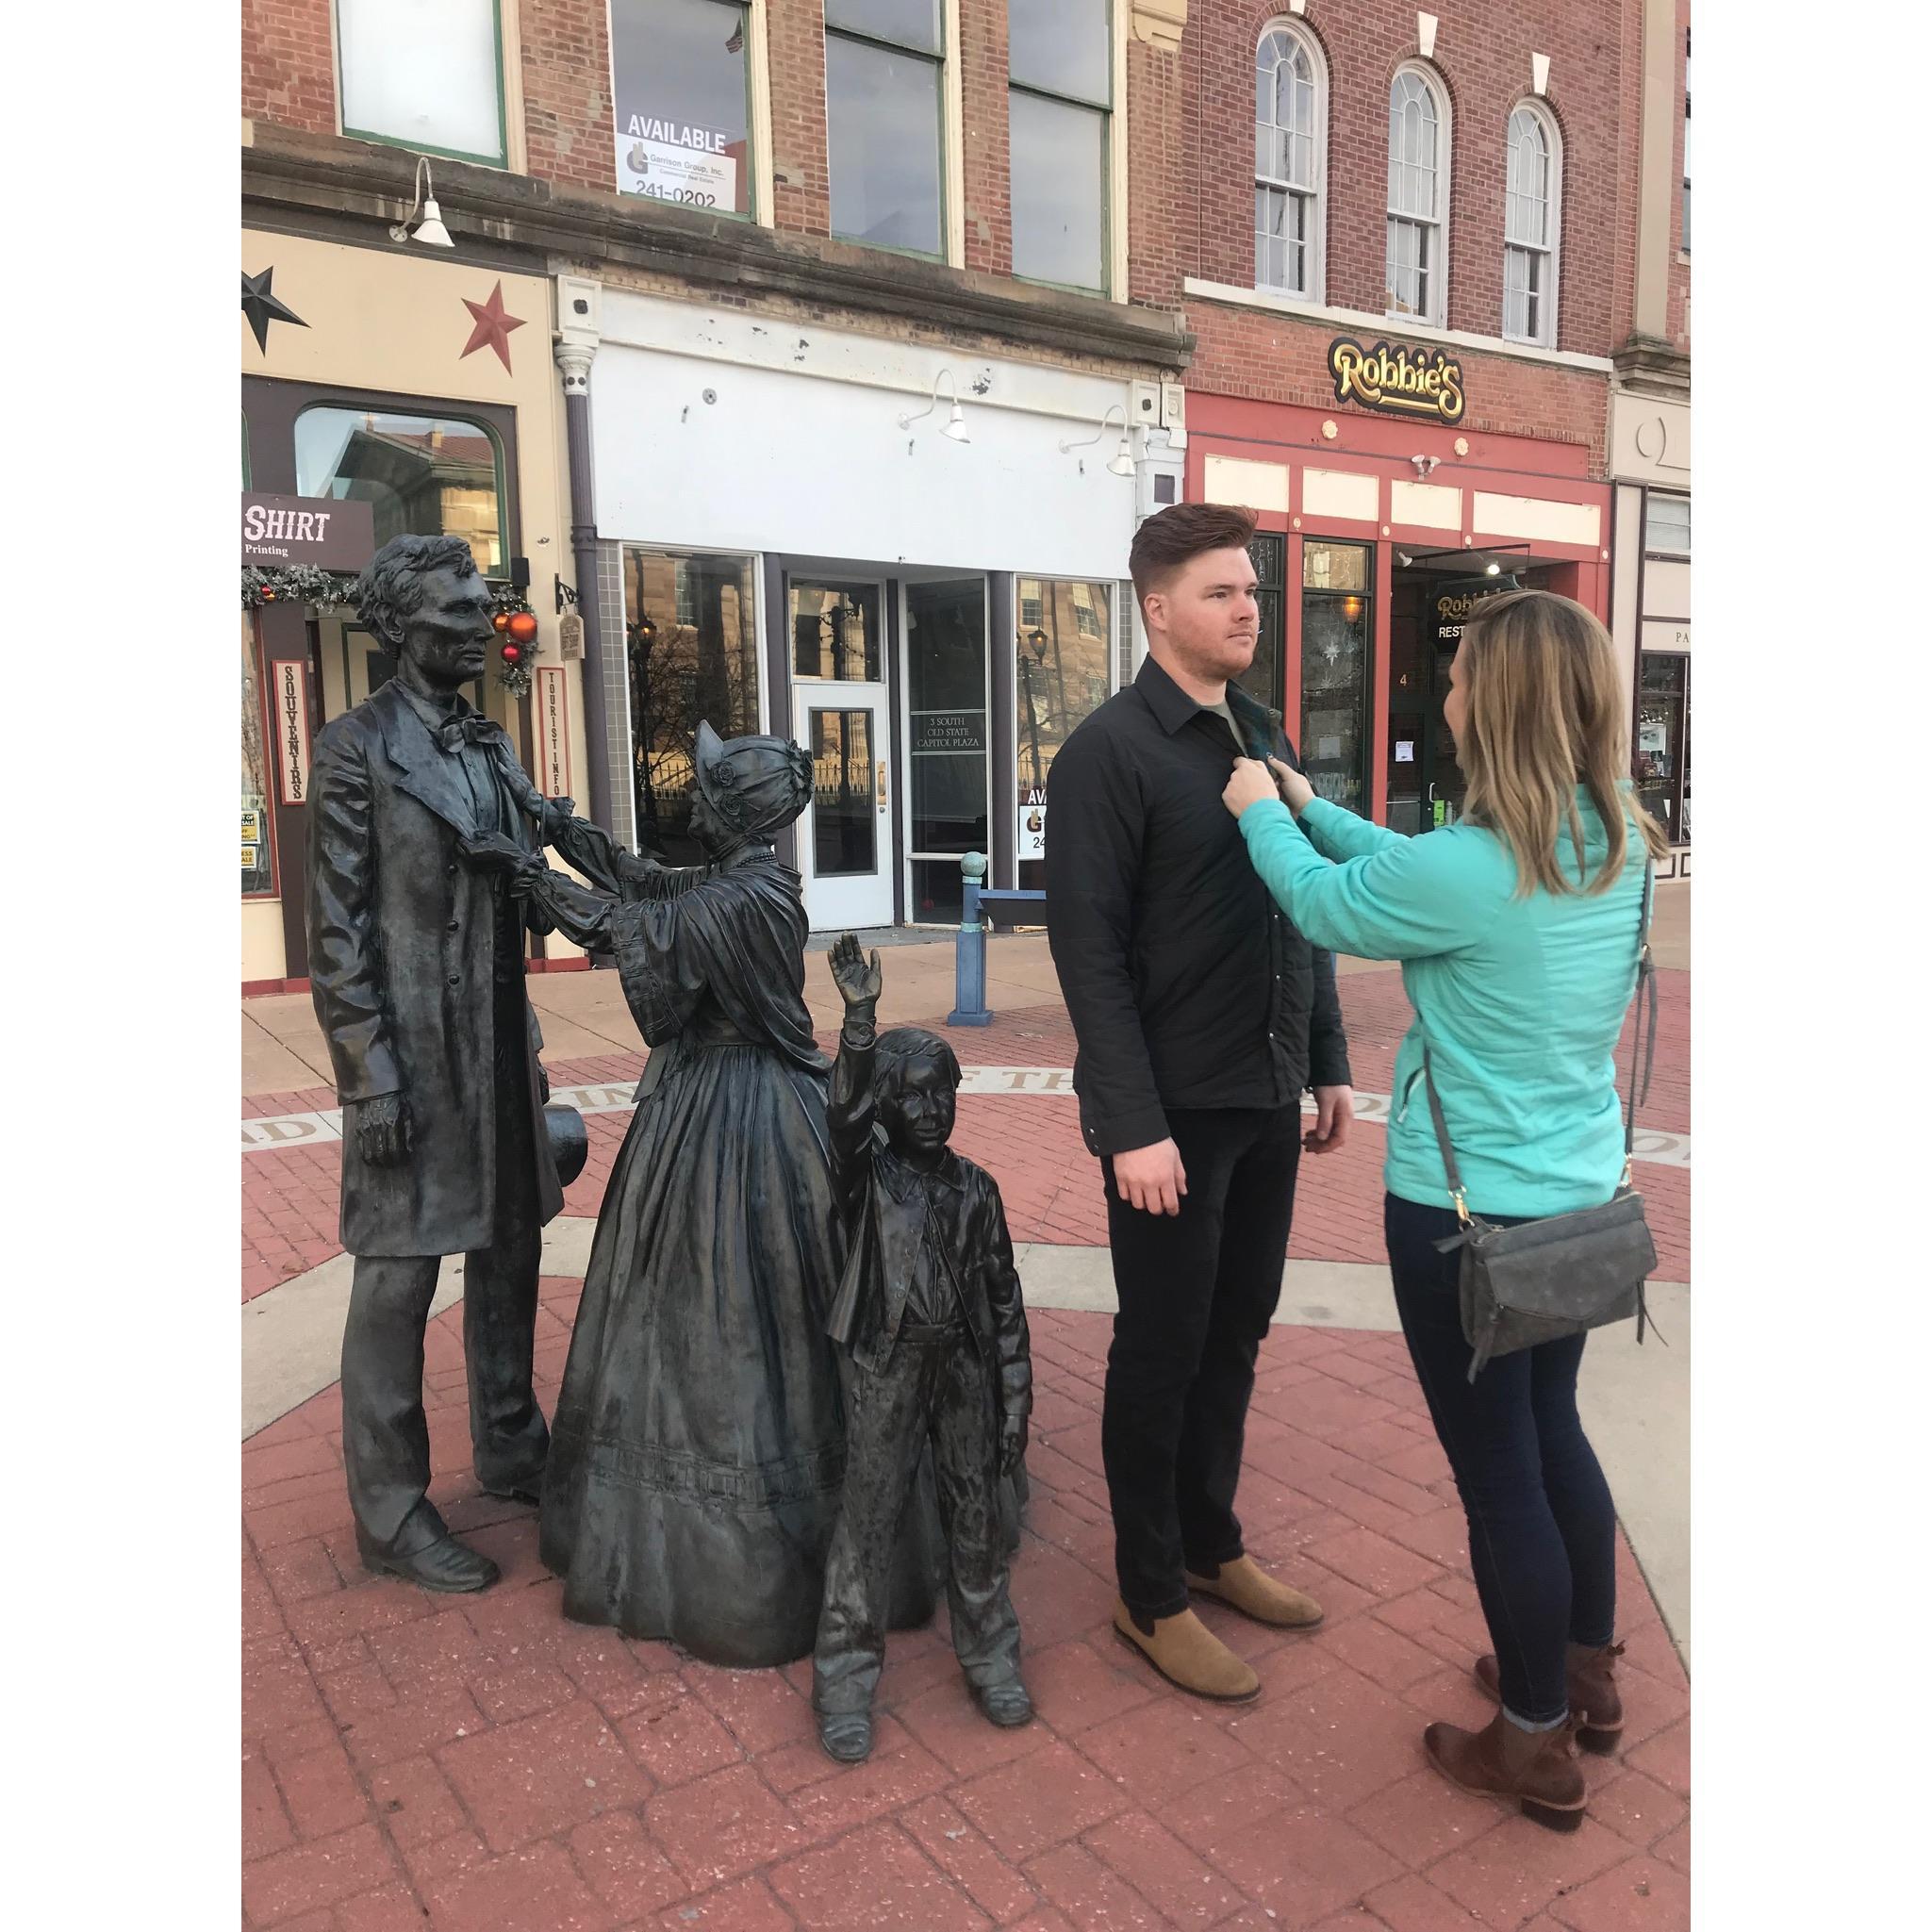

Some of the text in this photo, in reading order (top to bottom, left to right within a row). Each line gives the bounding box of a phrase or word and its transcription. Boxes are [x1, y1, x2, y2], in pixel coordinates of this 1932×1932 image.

[628, 114, 726, 155] AVAILABLE
[650, 154, 724, 176] Garrison Group, Inc.
[636, 179, 717, 207] 241-0202
[244, 504, 330, 542] SHIRT
[245, 544, 289, 557] Printing
[1399, 674, 1408, 686] 4
[937, 718, 965, 726] SOUTH
[946, 728, 969, 736] STATE
[284, 666, 302, 800] SOUVENIRS
[549, 672, 560, 796] TOURIST INFO
[916, 738, 979, 748] CAPITOL PLAZA
[1001, 1071, 1074, 1089] TH
